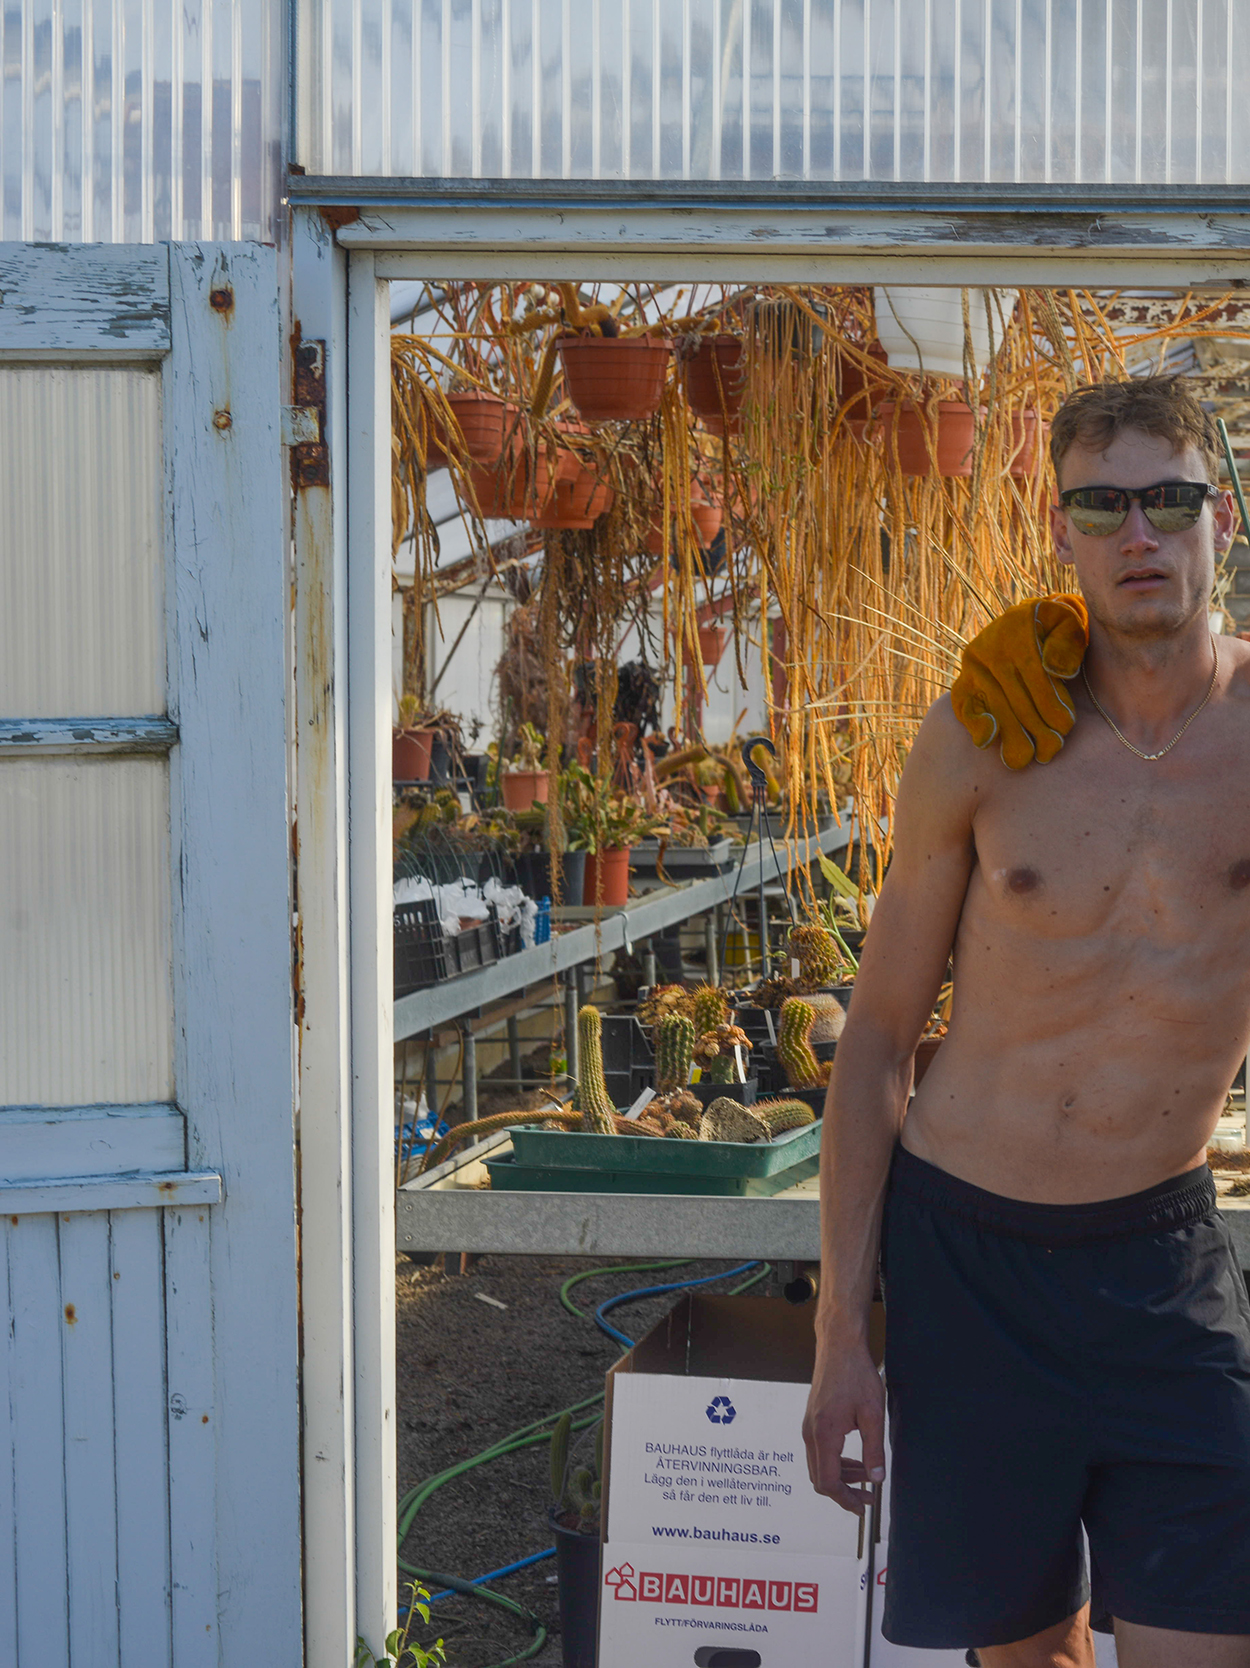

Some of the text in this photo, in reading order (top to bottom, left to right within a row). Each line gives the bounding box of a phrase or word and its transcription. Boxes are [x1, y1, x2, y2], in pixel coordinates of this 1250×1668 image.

[645, 1443, 794, 1462] BAUHAUS flyttlåda är helt
[656, 1457, 781, 1477] ÅTERVINNINGSBAR.
[644, 1474, 792, 1495] Lägg den i wellåtervinning
[662, 1489, 771, 1506] så får den ett liv till.
[652, 1525, 780, 1544] www.bauhaus.se
[641, 1575, 816, 1610] BAUHAUS
[655, 1618, 768, 1633] FLYTT/FÖRVARINGSLÅDA
